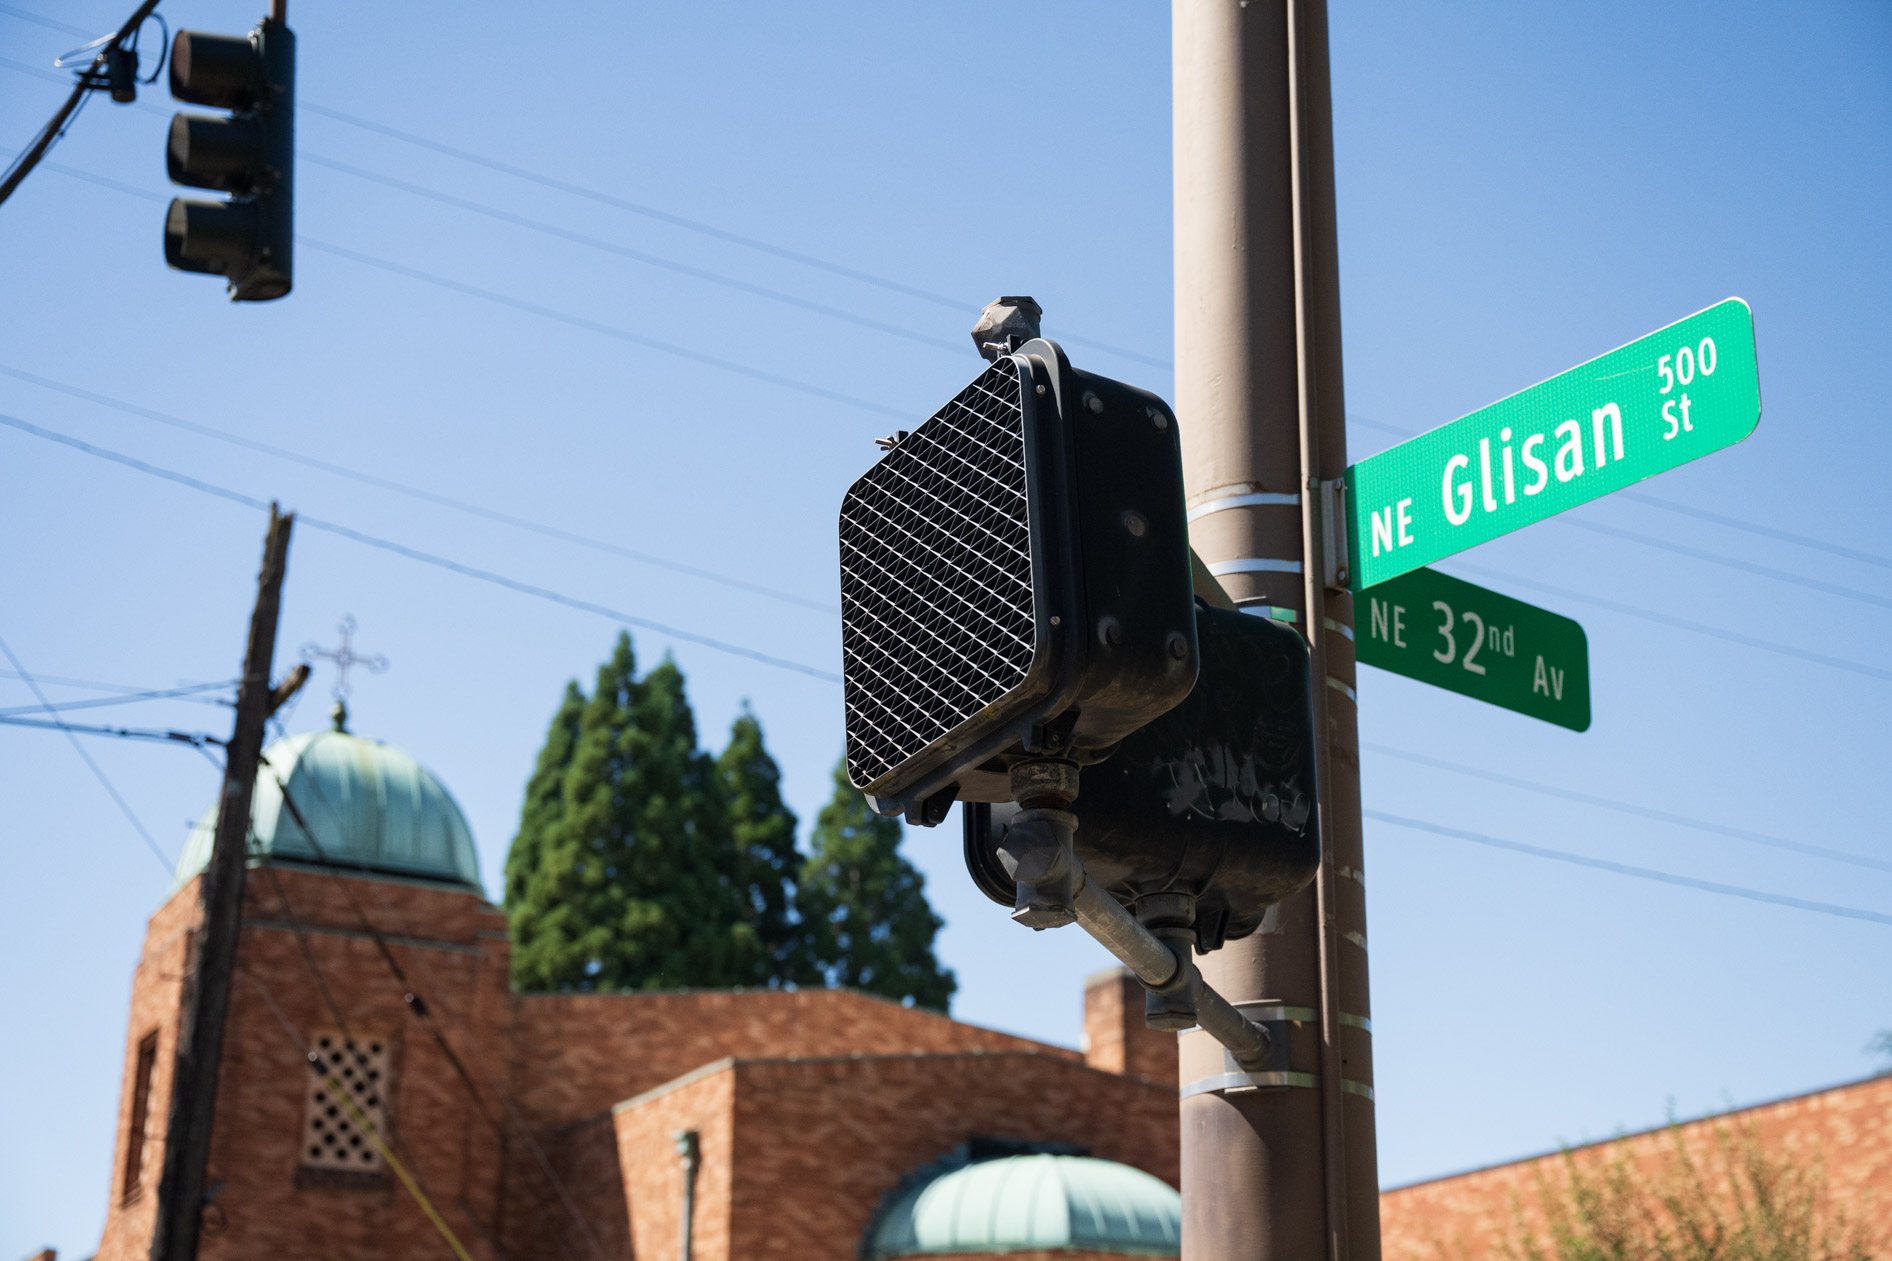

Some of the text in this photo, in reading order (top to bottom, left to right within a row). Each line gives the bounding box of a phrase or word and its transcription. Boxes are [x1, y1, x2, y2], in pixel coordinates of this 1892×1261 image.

[1657, 336, 1717, 394] 500
[1371, 393, 1694, 557] NE Glisan St
[1370, 597, 1565, 701] NE 32nd Av
